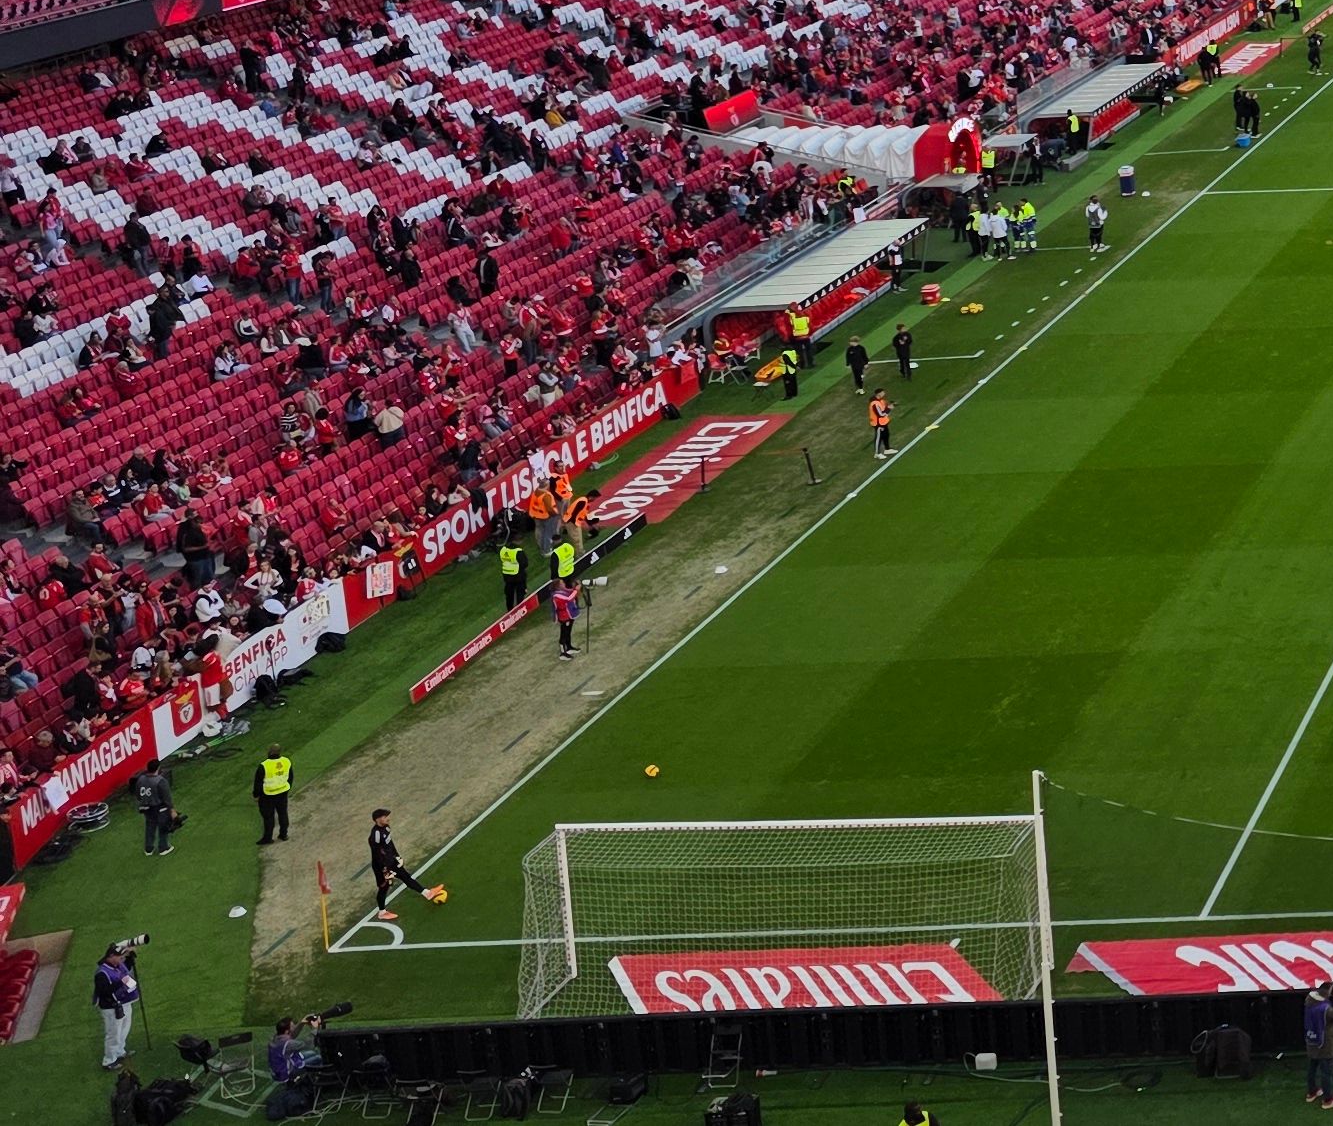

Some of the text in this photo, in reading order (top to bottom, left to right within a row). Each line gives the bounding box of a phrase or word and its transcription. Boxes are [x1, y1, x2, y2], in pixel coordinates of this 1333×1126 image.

[499, 441, 575, 522] LISOA
[575, 429, 589, 463] E
[590, 381, 668, 451] BENFICA
[587, 419, 770, 522] Emirates
[225, 627, 287, 679] BENFICA
[265, 645, 289, 672] APP
[20, 721, 143, 837] MAI ANTAGENS
